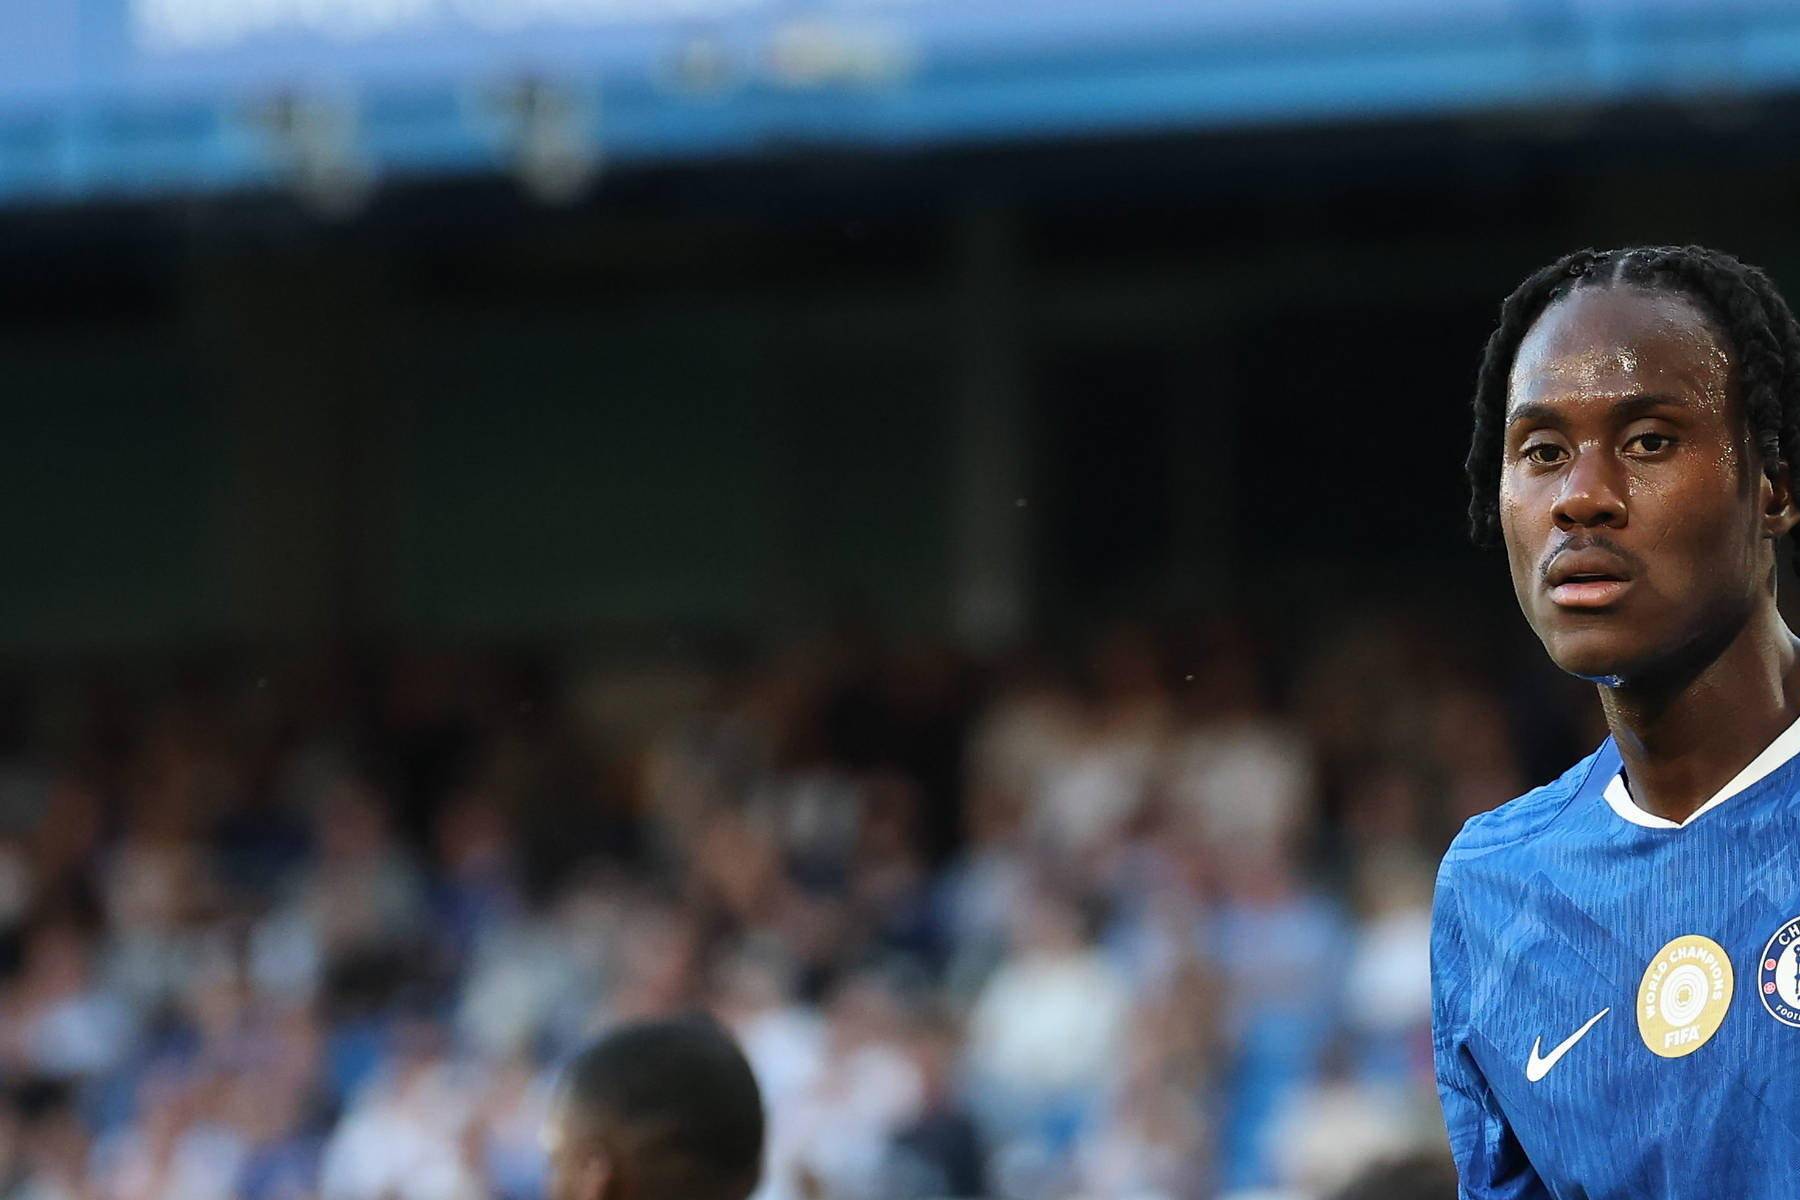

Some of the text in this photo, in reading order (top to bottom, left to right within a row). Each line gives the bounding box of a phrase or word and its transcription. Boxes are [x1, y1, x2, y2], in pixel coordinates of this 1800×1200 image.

[1646, 946, 1723, 1020] WORLD CHAMPIONS
[1664, 1025, 1700, 1049] FIFA
